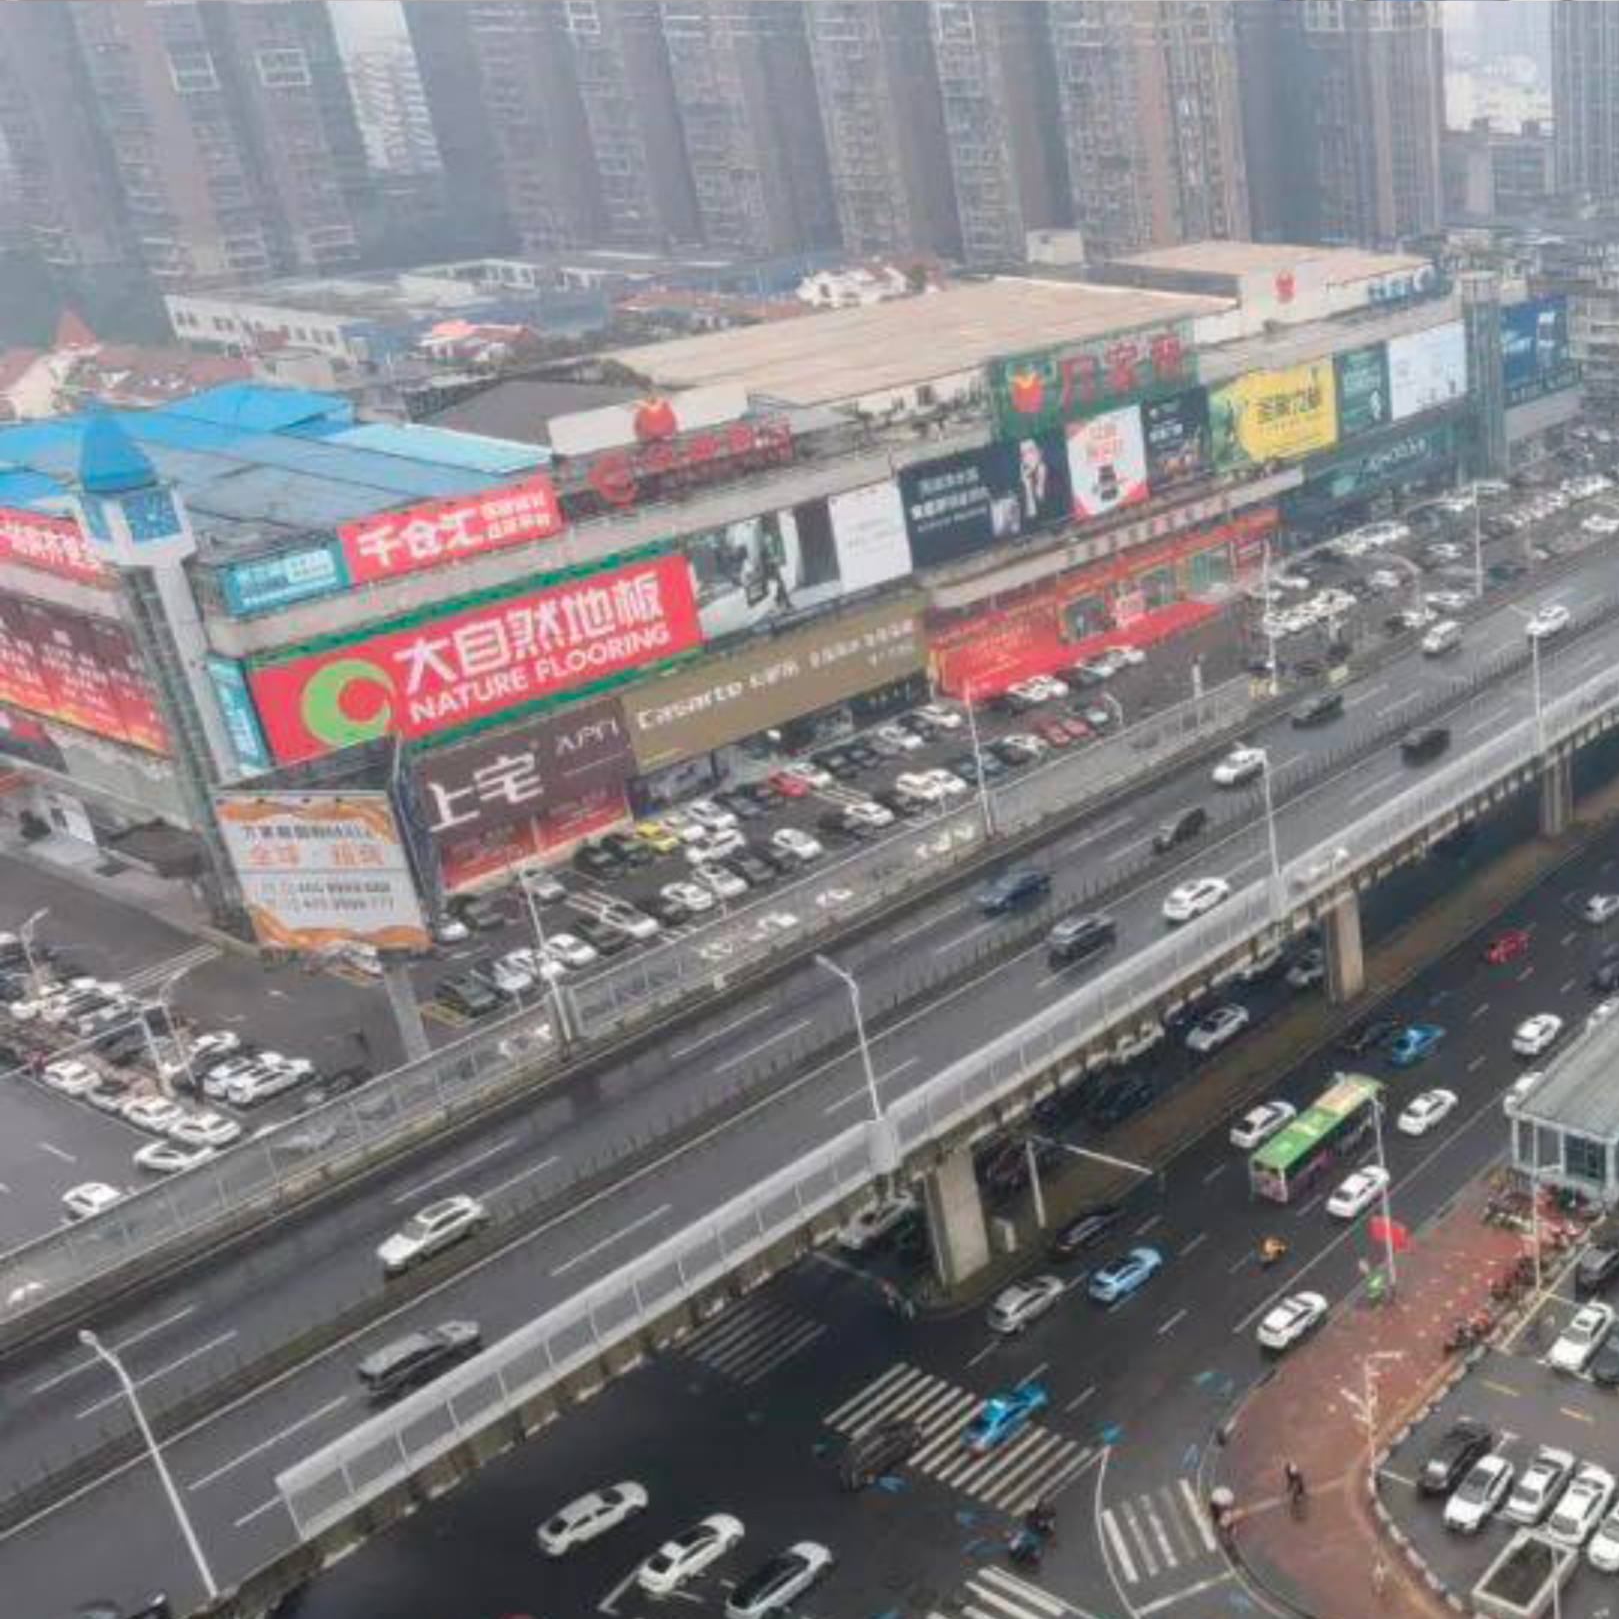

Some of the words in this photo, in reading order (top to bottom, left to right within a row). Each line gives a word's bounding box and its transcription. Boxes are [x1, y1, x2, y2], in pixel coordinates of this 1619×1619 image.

[392, 571, 665, 695] 大自然地板
[409, 665, 529, 723] NATURE
[534, 623, 671, 684] FLOORING
[426, 752, 544, 832] 上宅
